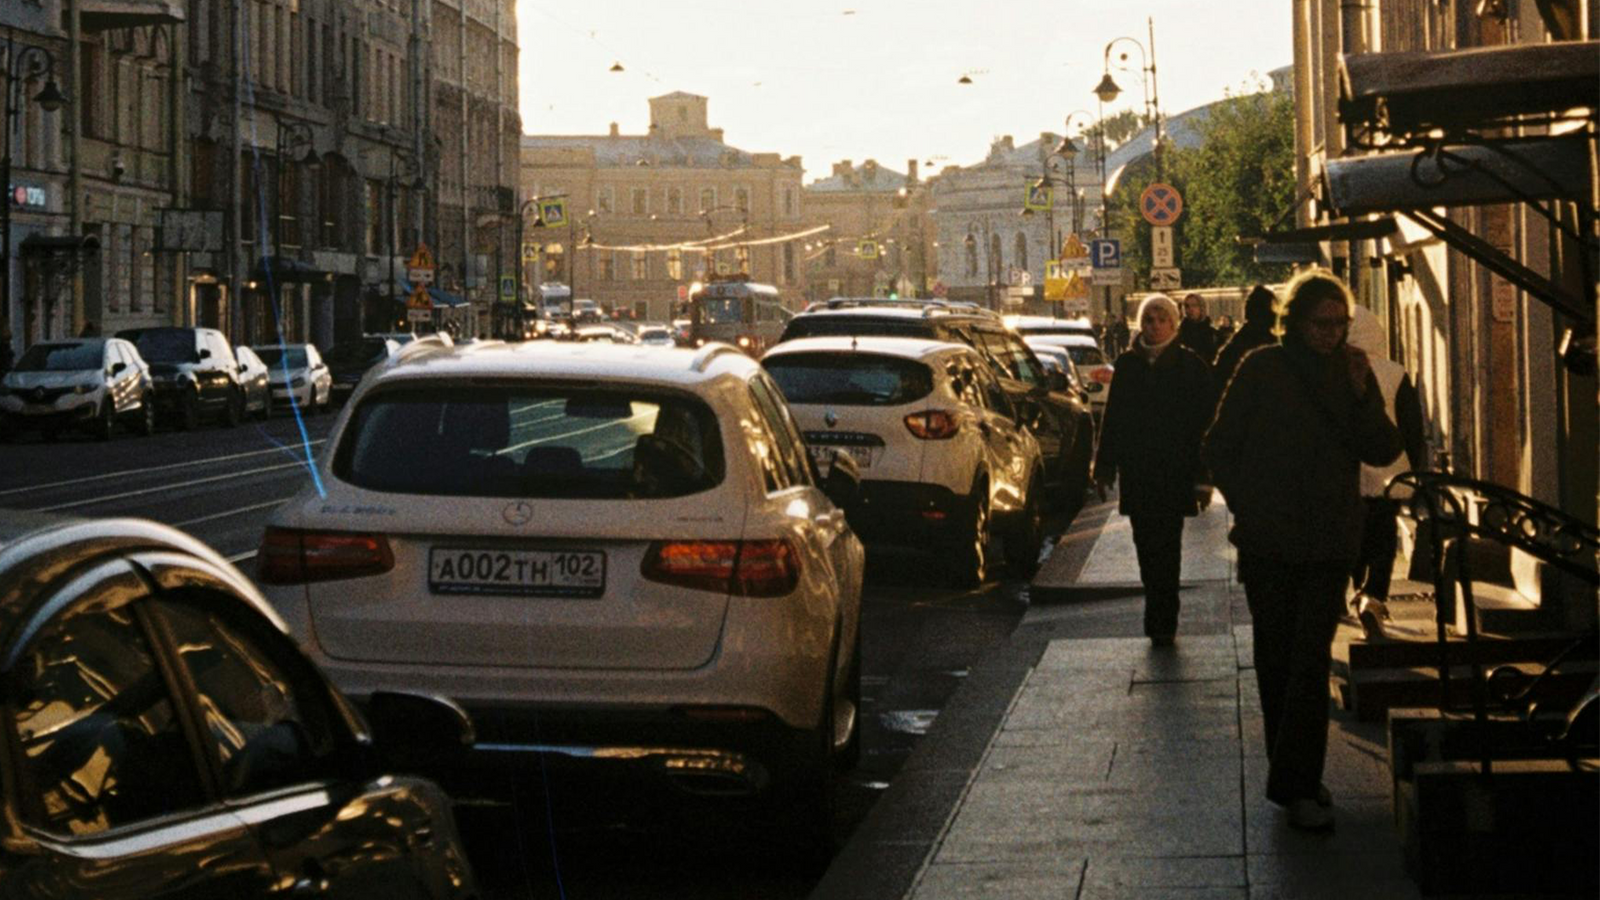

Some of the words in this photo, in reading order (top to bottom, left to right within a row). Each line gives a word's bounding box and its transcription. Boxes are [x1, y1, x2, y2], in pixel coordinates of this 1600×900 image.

[1100, 242, 1115, 266] P
[439, 553, 547, 581] А002ТН
[555, 554, 595, 575] 102
